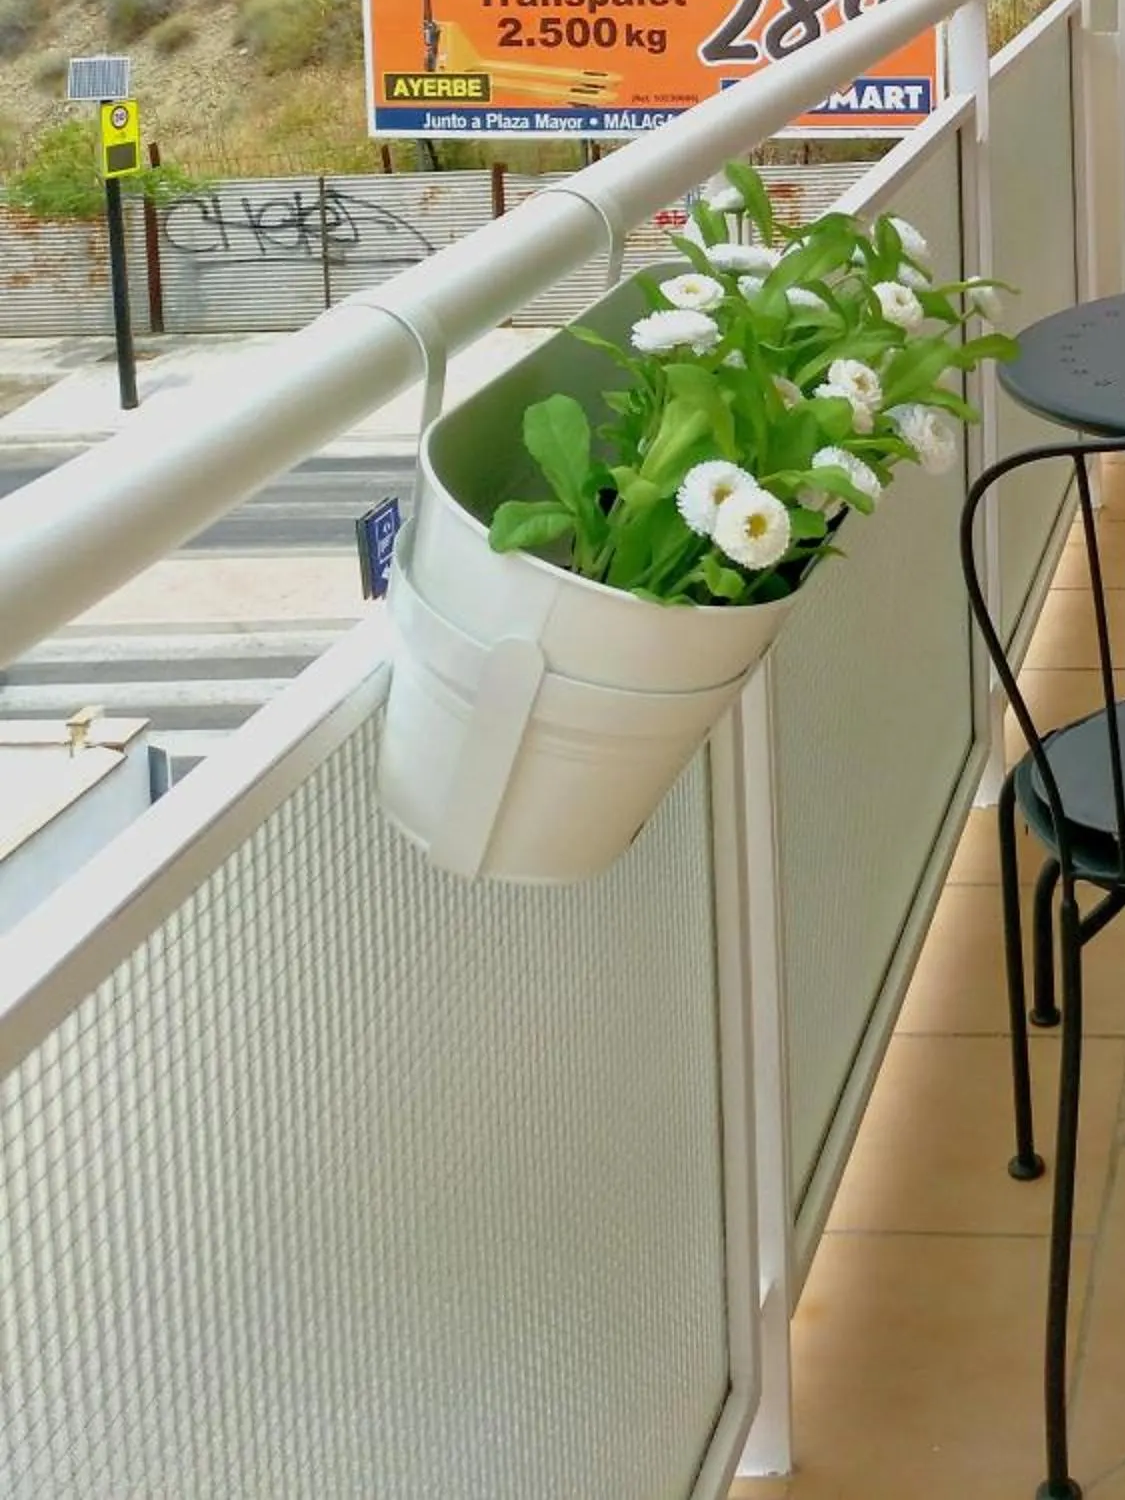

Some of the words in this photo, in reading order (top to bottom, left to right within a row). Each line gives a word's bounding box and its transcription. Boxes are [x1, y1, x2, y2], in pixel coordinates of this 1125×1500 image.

[497, 17, 617, 48] 2.500
[625, 23, 667, 55] kg
[393, 77, 483, 97] AYERBE
[423, 113, 467, 129] Junto
[471, 117, 481, 129] a
[486, 113, 529, 129] Plaza
[535, 114, 584, 132] Mayor
